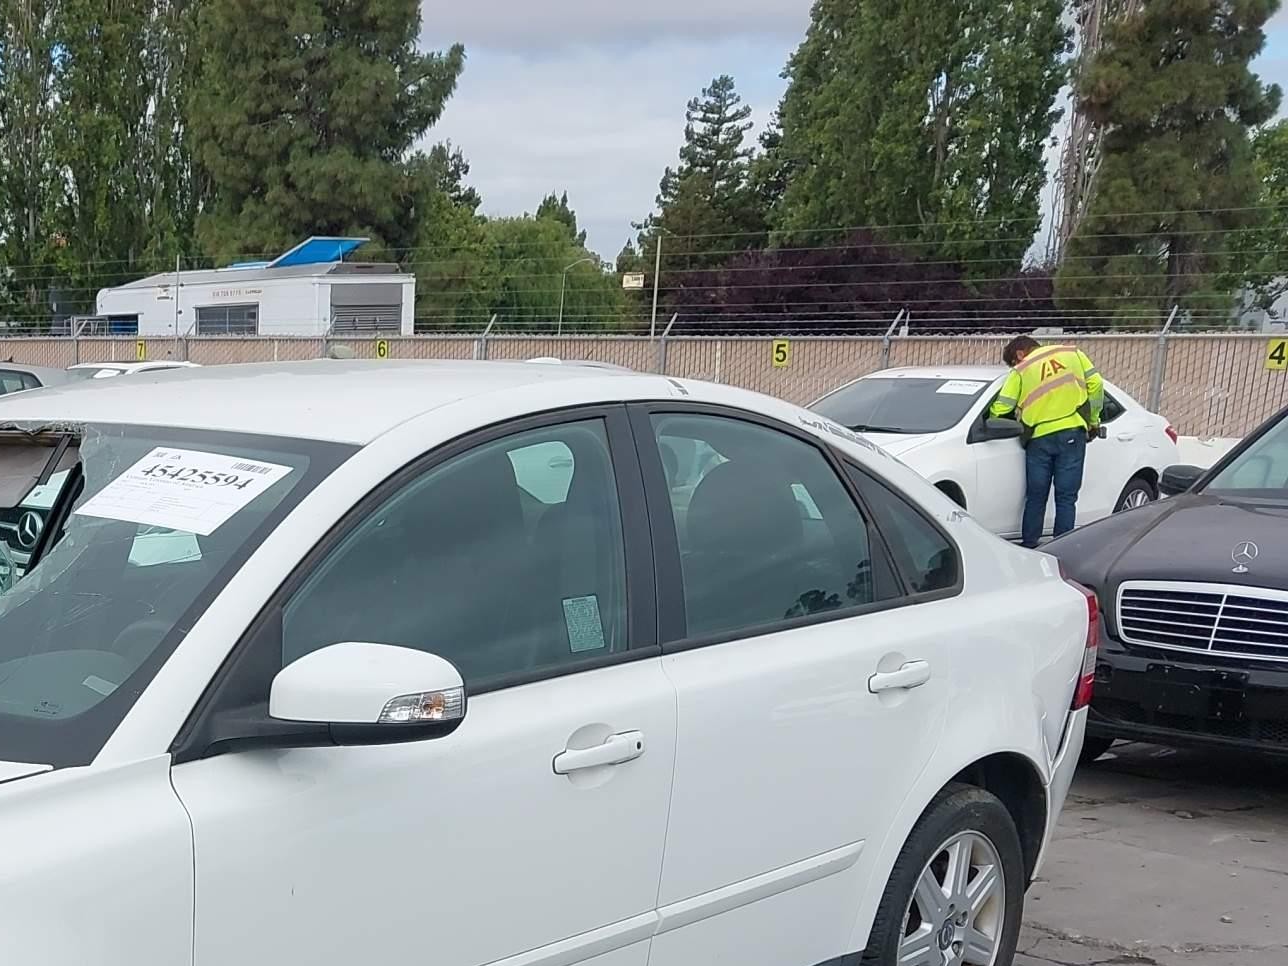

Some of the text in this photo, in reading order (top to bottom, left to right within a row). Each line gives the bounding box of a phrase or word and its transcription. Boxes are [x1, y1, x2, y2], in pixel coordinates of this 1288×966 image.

[137, 342, 144, 357] 7
[378, 340, 386, 358] 6
[775, 343, 787, 363] 5
[1268, 341, 1286, 365] 4
[141, 463, 255, 490] 45425594
